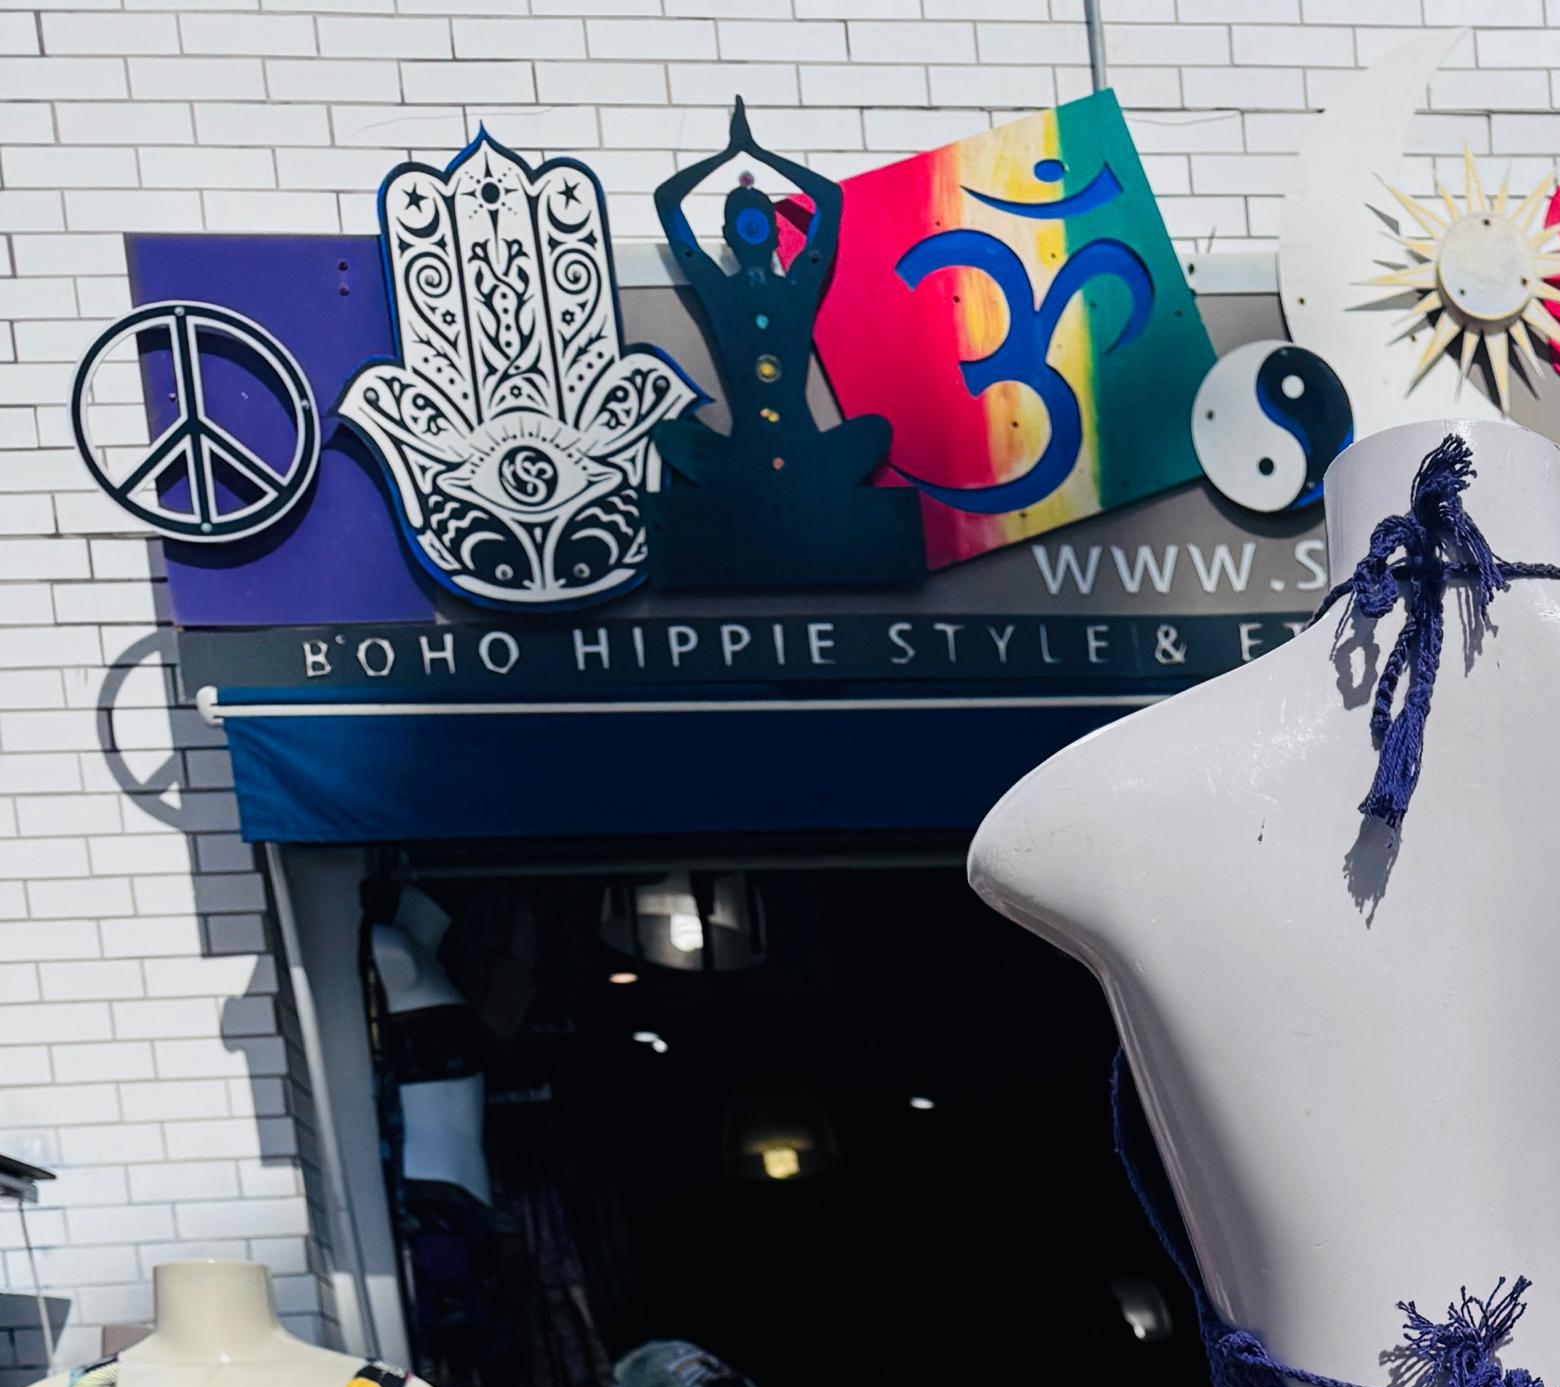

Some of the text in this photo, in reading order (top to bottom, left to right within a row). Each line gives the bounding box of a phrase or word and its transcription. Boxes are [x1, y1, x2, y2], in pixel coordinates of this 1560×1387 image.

[302, 631, 520, 677] BOHO
[575, 623, 837, 672] HIPPIE
[889, 623, 1113, 665] STYLE
[1154, 624, 1188, 665] &
